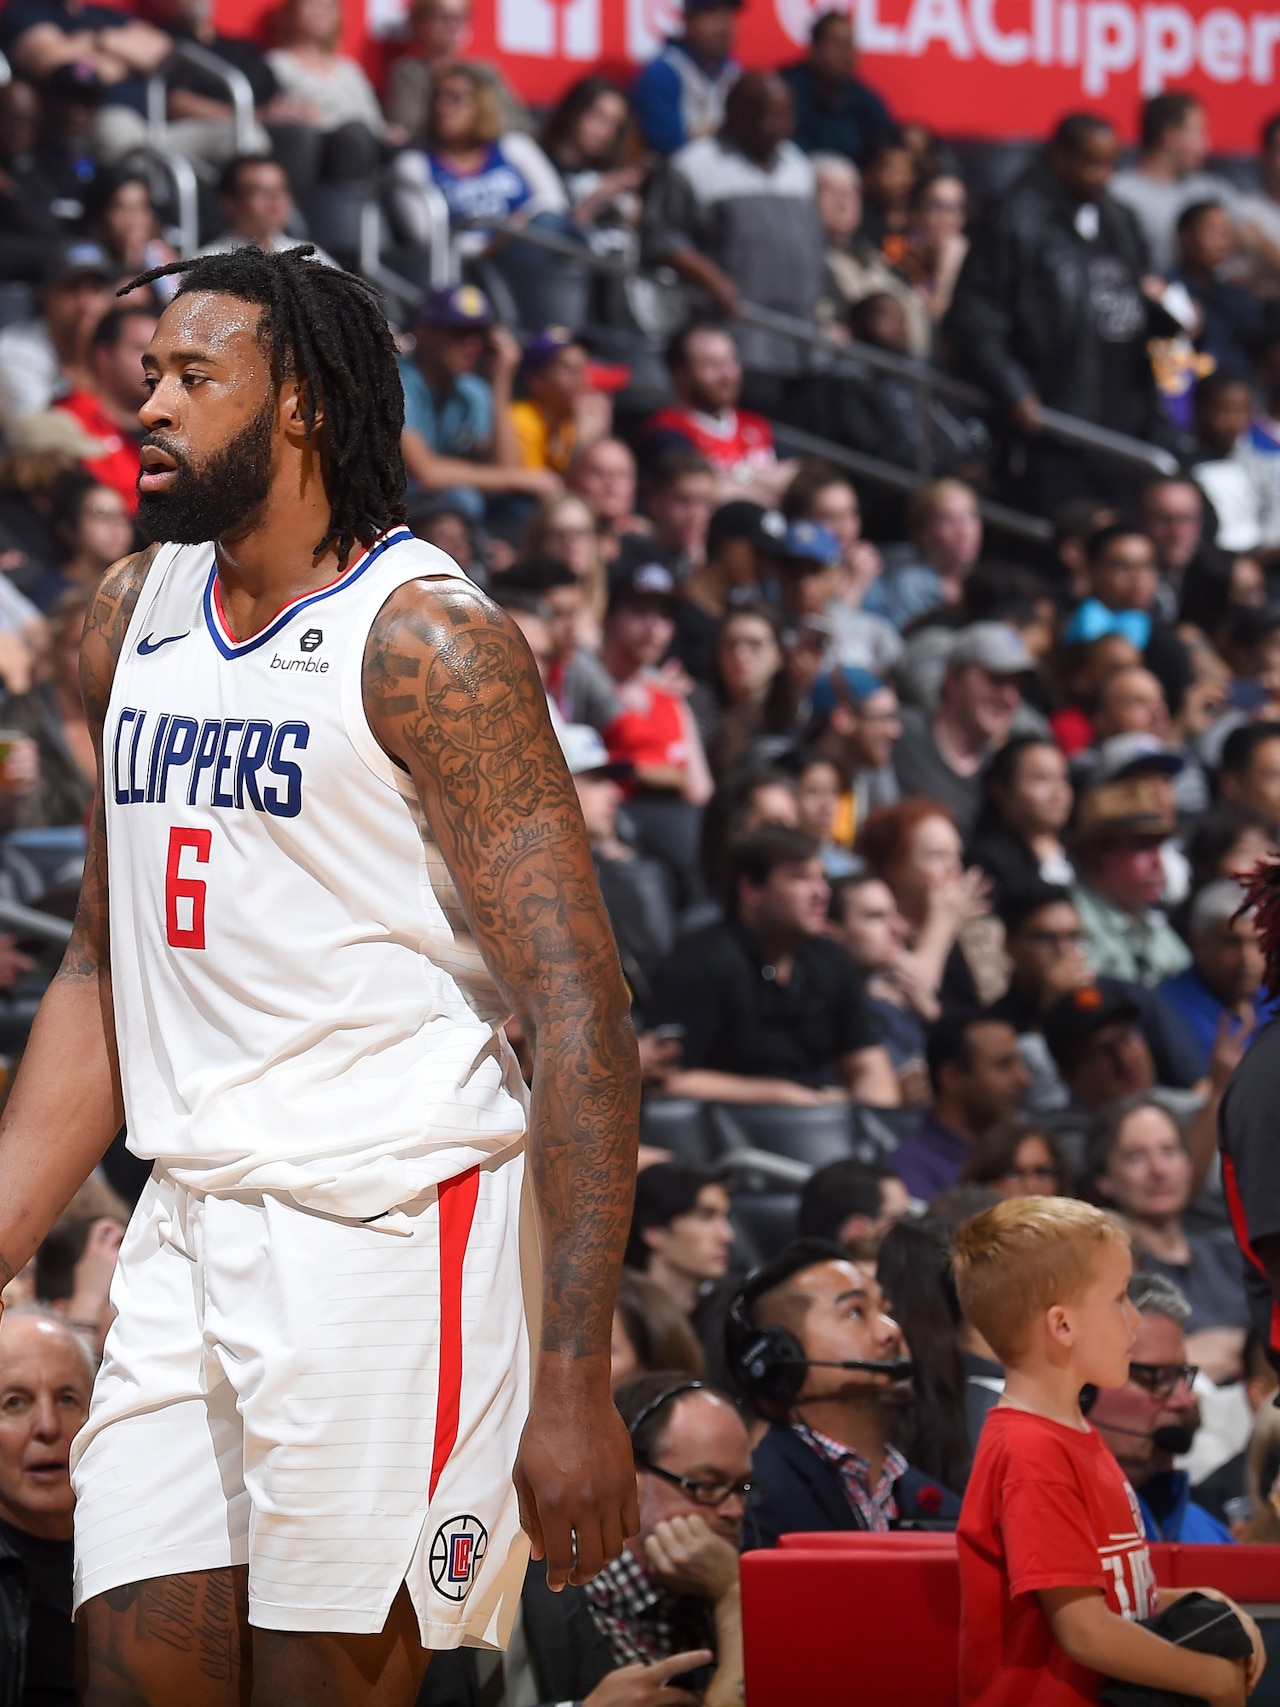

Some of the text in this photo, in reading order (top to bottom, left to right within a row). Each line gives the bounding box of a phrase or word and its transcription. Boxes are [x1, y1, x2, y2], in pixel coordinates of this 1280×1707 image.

[270, 653, 330, 673] bumble
[113, 707, 310, 818] CLIPPERS
[165, 826, 213, 950] 6
